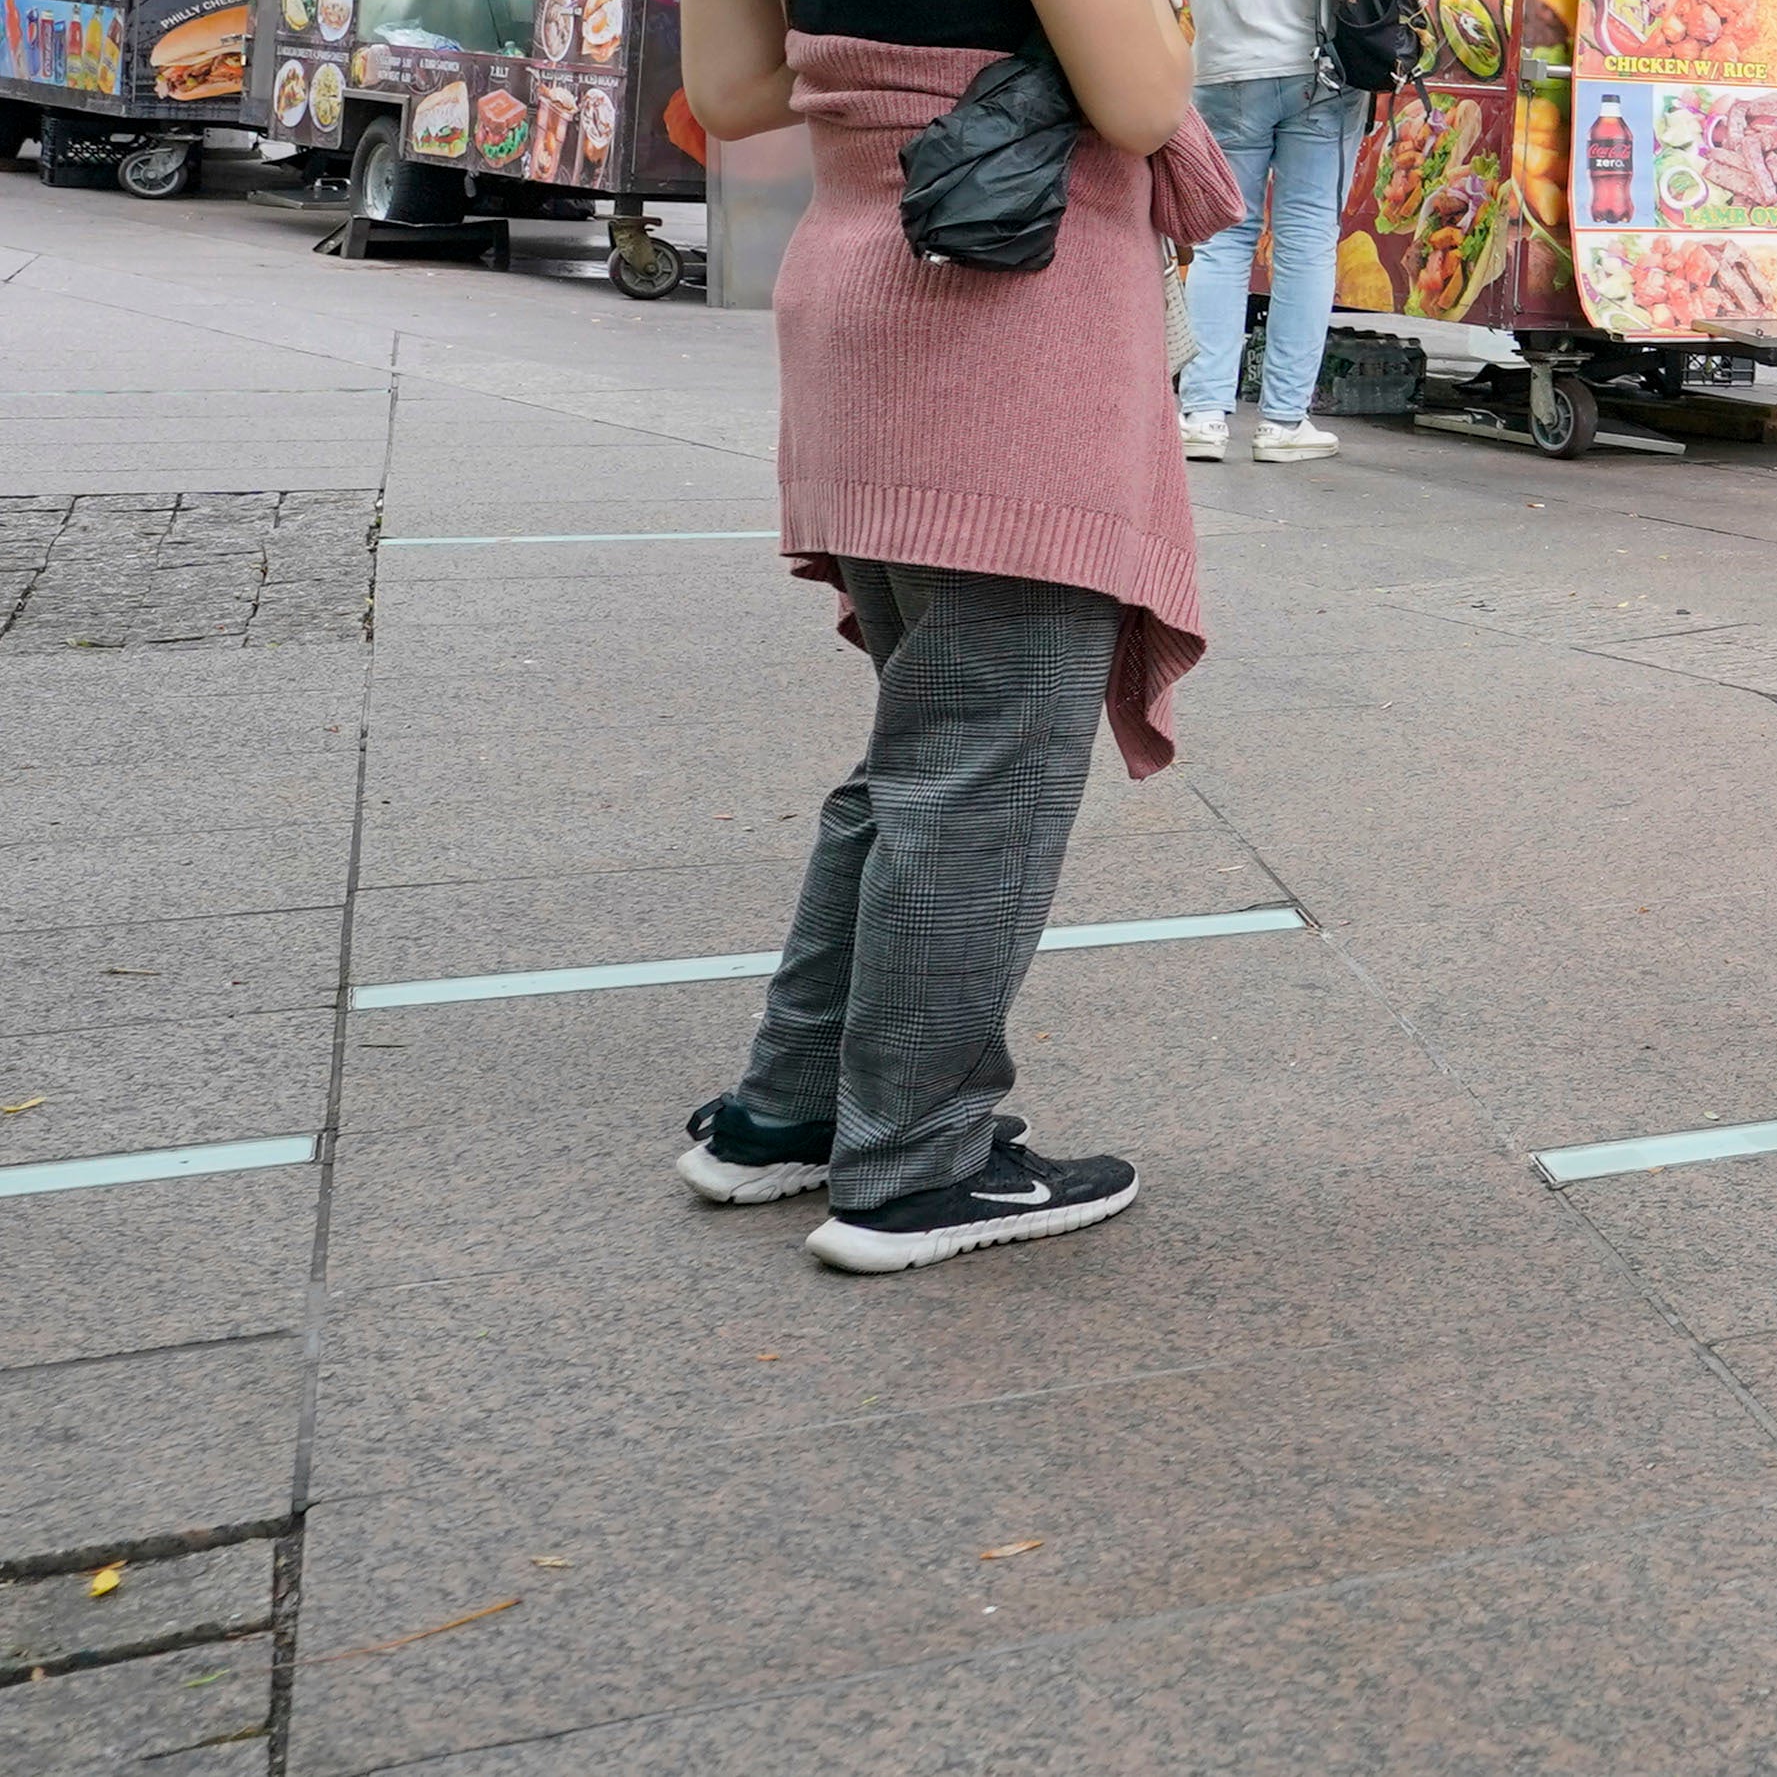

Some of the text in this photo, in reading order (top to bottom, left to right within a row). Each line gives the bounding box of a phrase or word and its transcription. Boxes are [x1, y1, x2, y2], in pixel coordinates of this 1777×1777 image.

[160, 3, 201, 29] PHILLY
[1604, 54, 1690, 77] CHICKEN
[1723, 60, 1768, 81] RICE
[1684, 206, 1749, 225] LAMB
